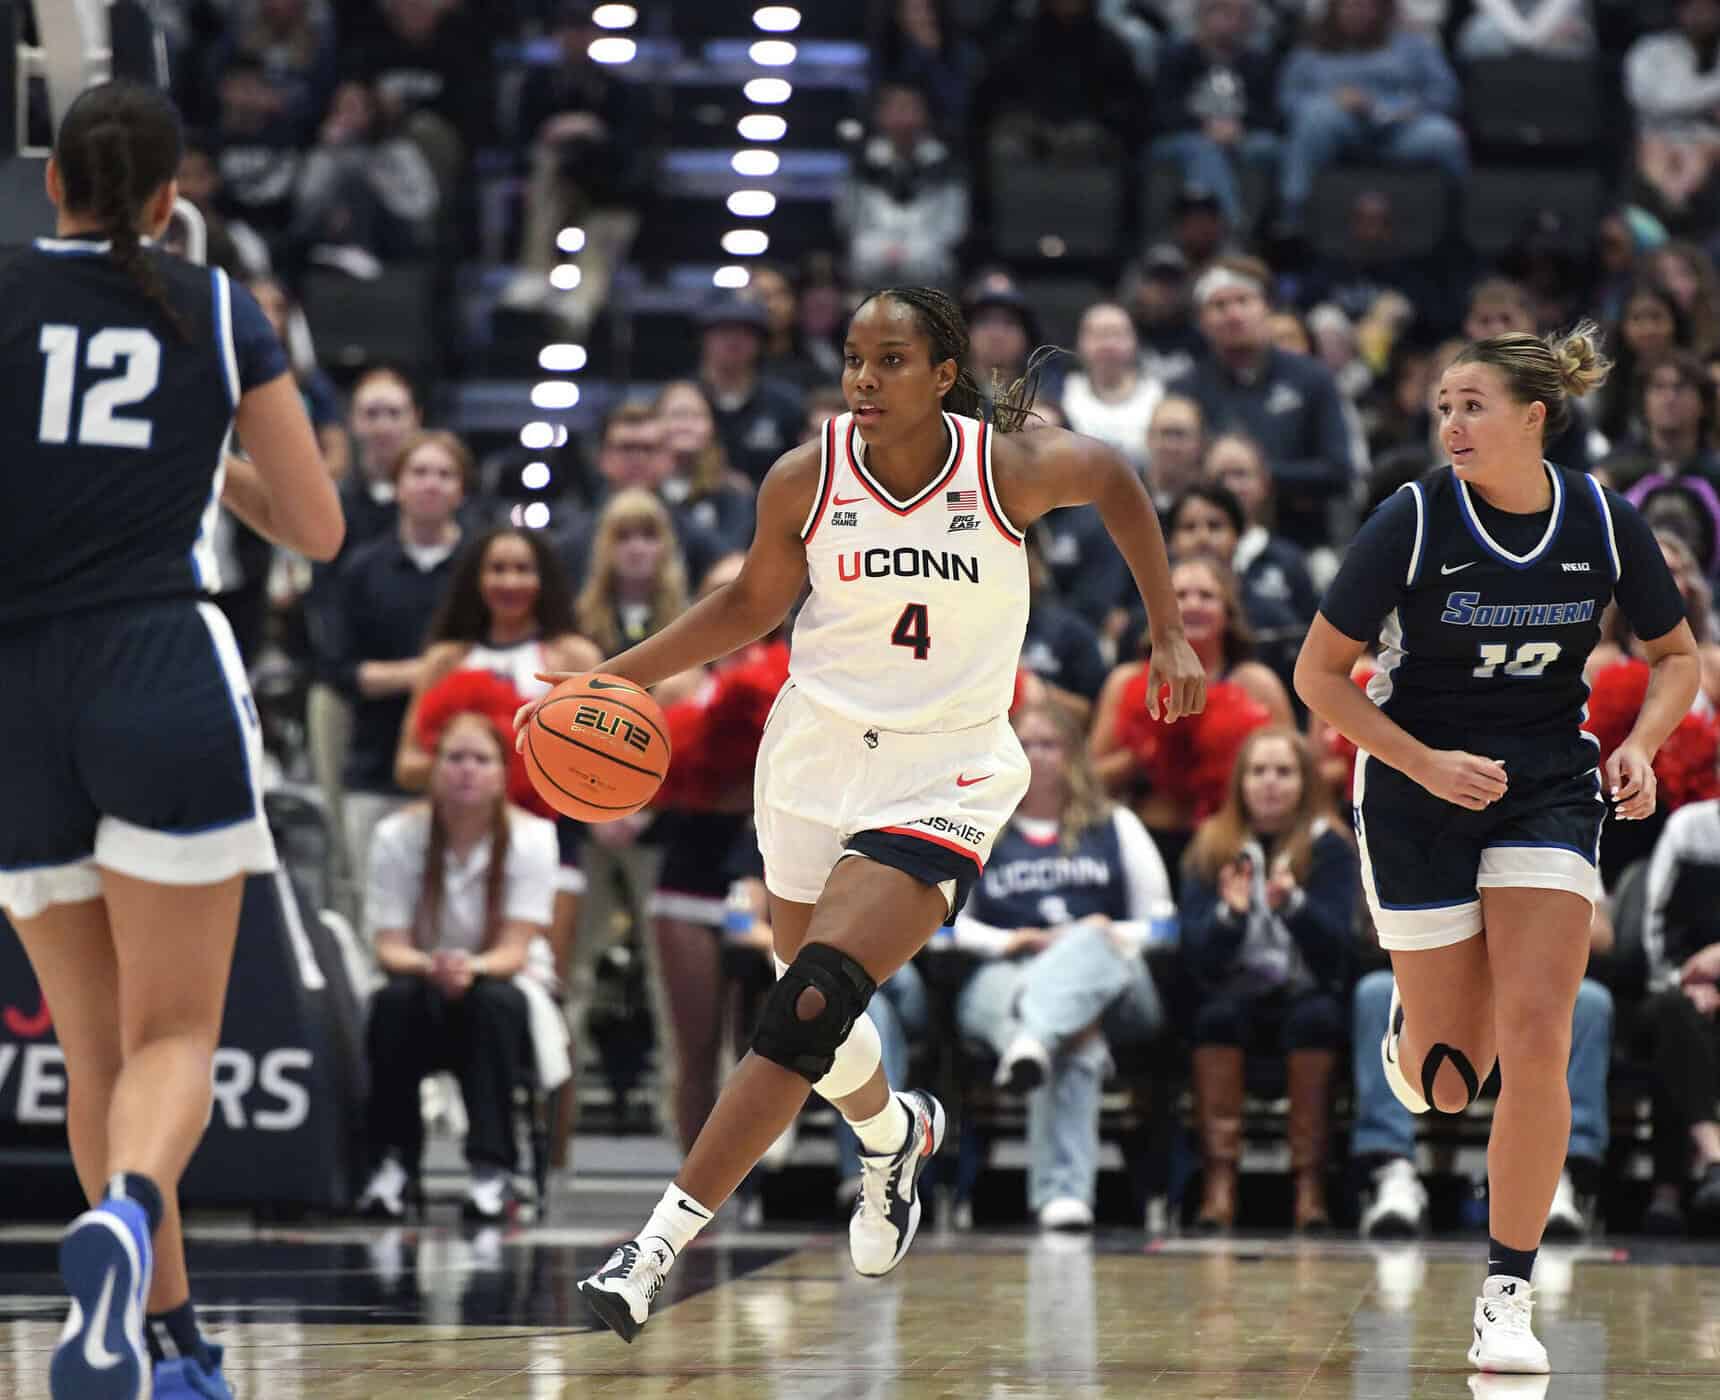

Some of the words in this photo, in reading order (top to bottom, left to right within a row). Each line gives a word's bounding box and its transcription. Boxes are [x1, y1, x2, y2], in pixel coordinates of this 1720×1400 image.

[38, 323, 161, 449] 12
[844, 511, 857, 520] THE
[950, 520, 982, 529] EAST
[952, 514, 976, 522] BIG
[838, 548, 979, 583] UCONN
[891, 602, 931, 660] 4
[574, 704, 651, 753] ELITE
[903, 816, 986, 846] USKIES
